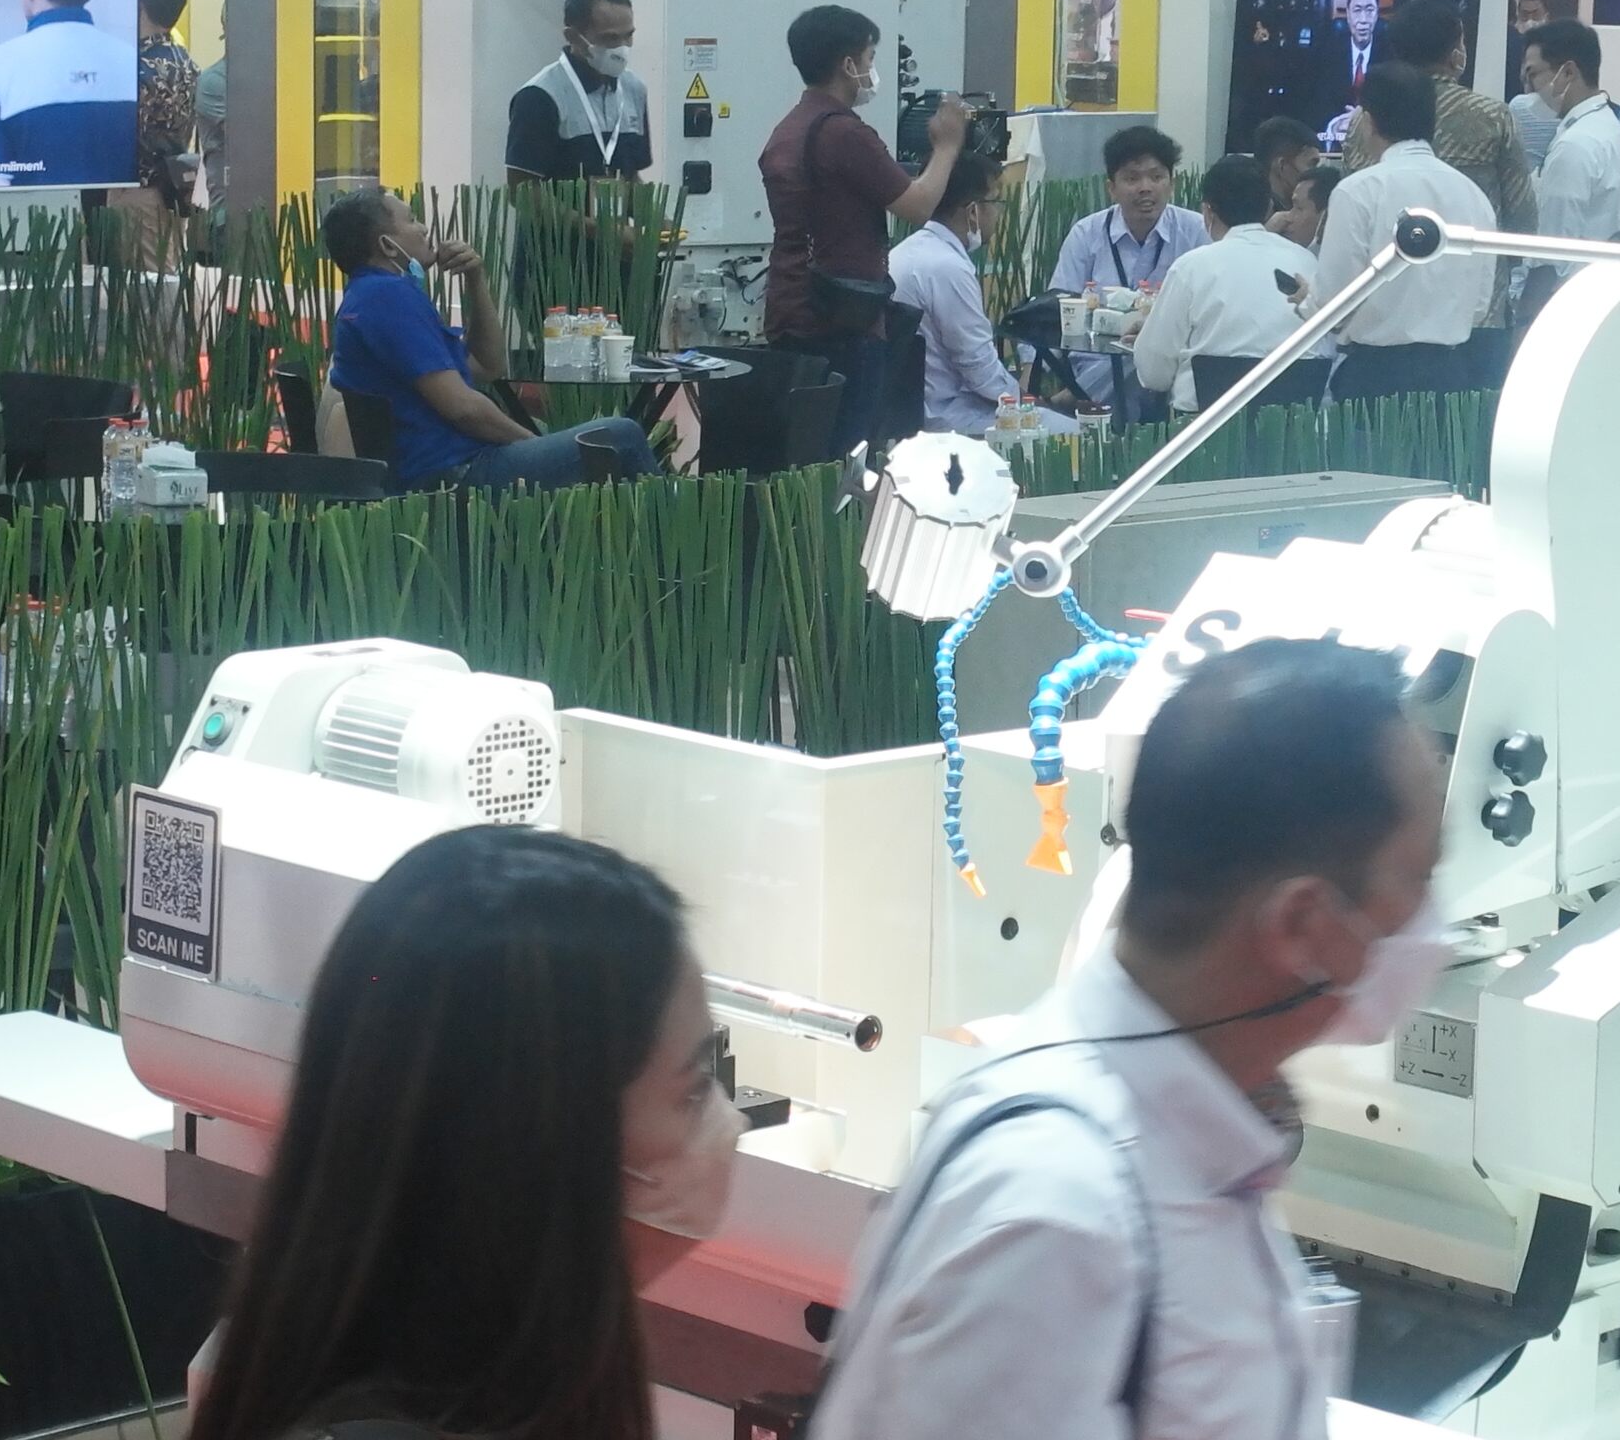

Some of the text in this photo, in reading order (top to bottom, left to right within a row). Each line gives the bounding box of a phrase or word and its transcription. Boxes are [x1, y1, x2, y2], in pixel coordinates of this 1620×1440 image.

[135, 926, 204, 965] SCAN ME
[1440, 1023, 1458, 1039] +X
[1399, 1060, 1416, 1075] +Z
